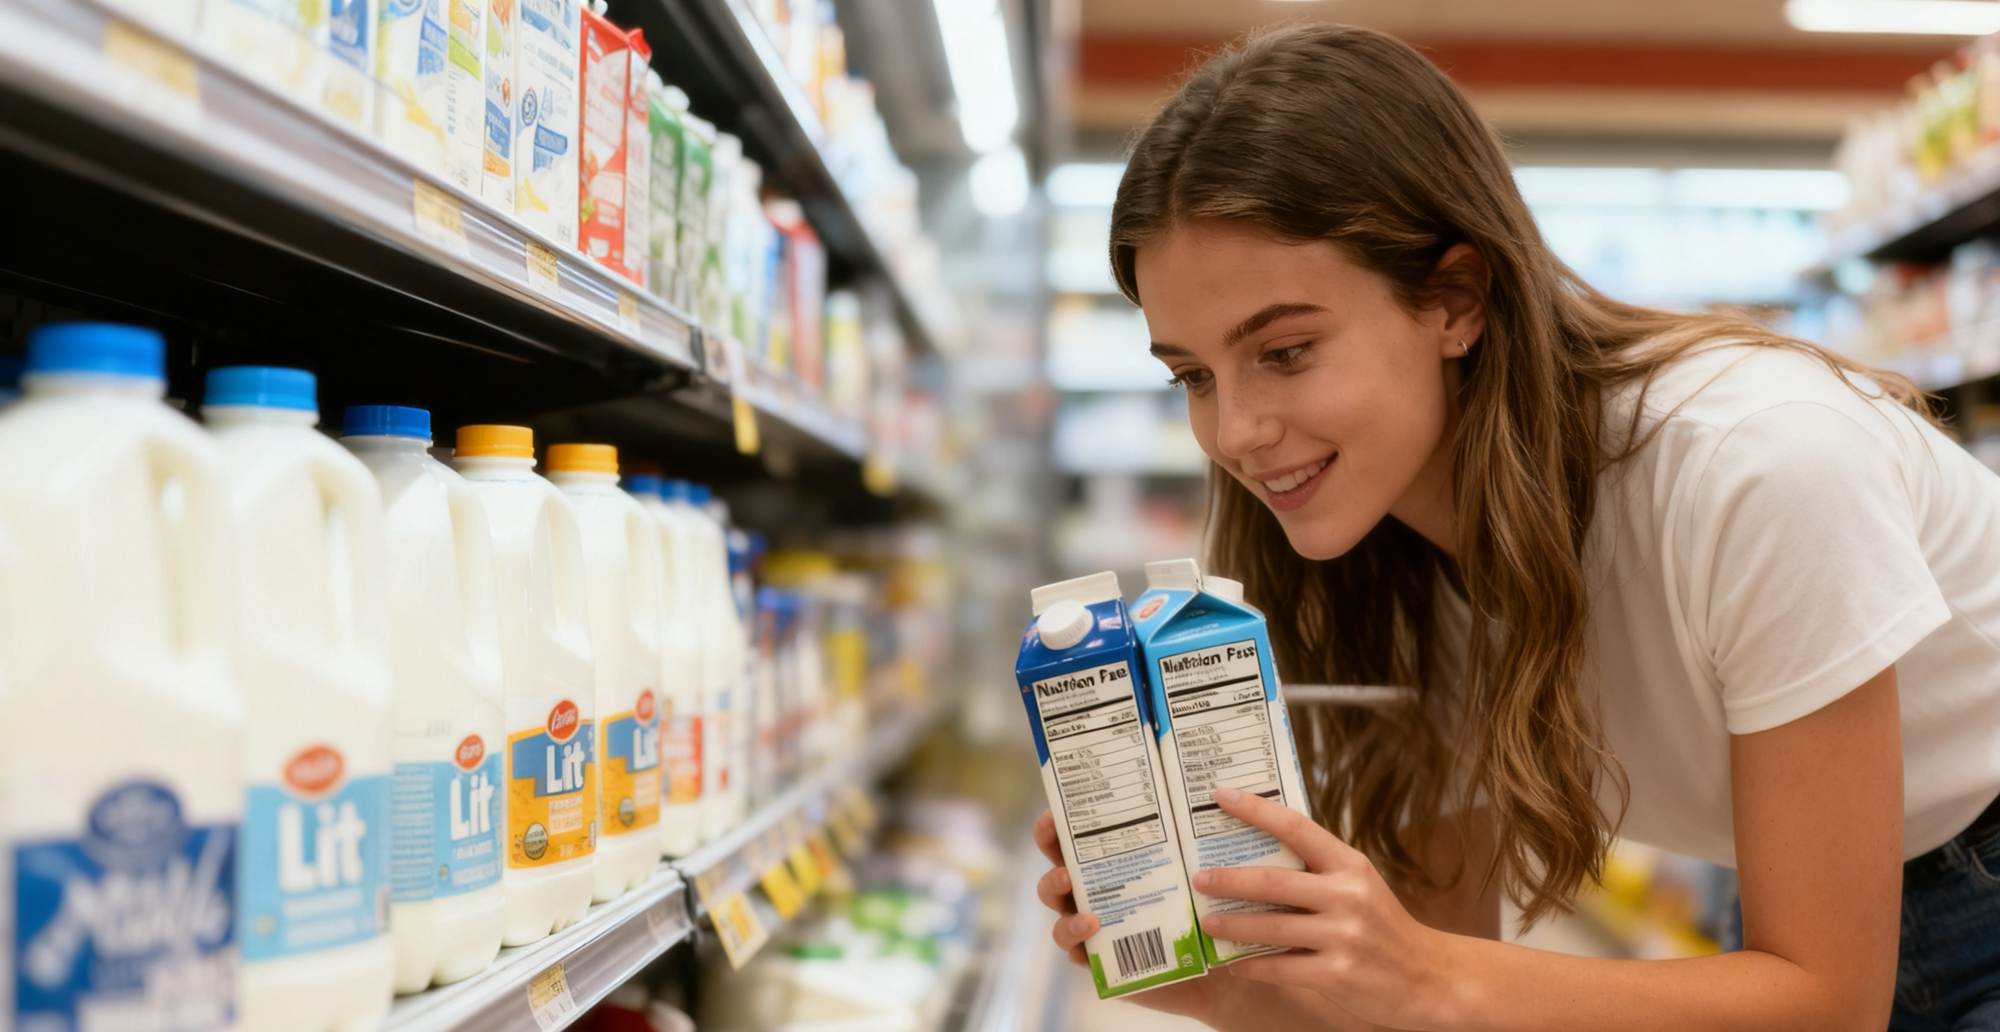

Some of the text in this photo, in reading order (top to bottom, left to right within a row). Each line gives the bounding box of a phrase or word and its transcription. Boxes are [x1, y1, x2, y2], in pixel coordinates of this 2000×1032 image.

[546, 741, 586, 794] Lit
[451, 771, 494, 840] Lit
[278, 800, 367, 892] Lit
